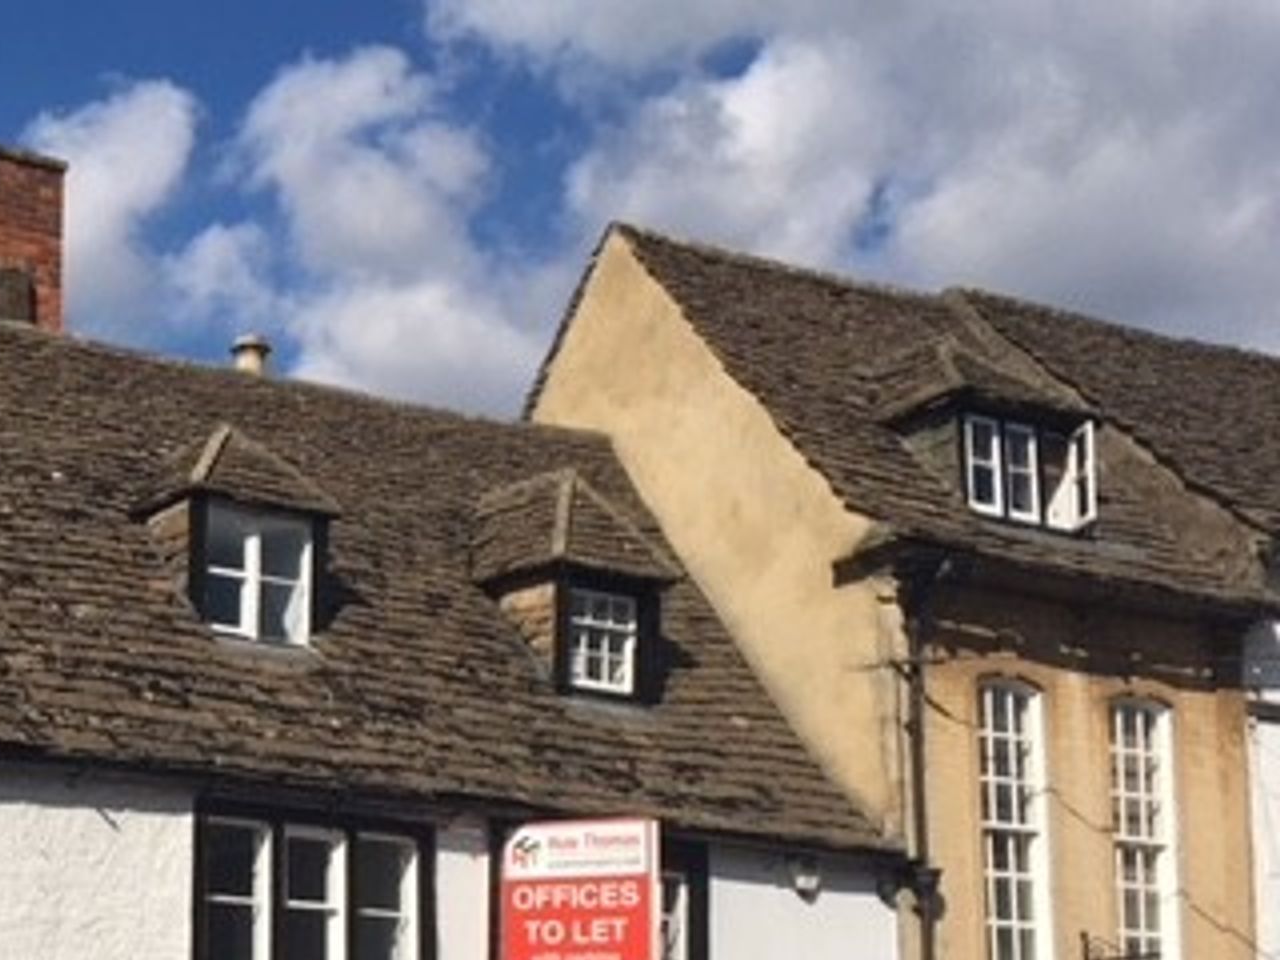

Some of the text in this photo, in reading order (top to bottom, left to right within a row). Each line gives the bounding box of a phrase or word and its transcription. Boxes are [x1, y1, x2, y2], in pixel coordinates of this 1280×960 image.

[512, 881, 640, 910] OFFICES
[524, 917, 629, 946] TO LET
